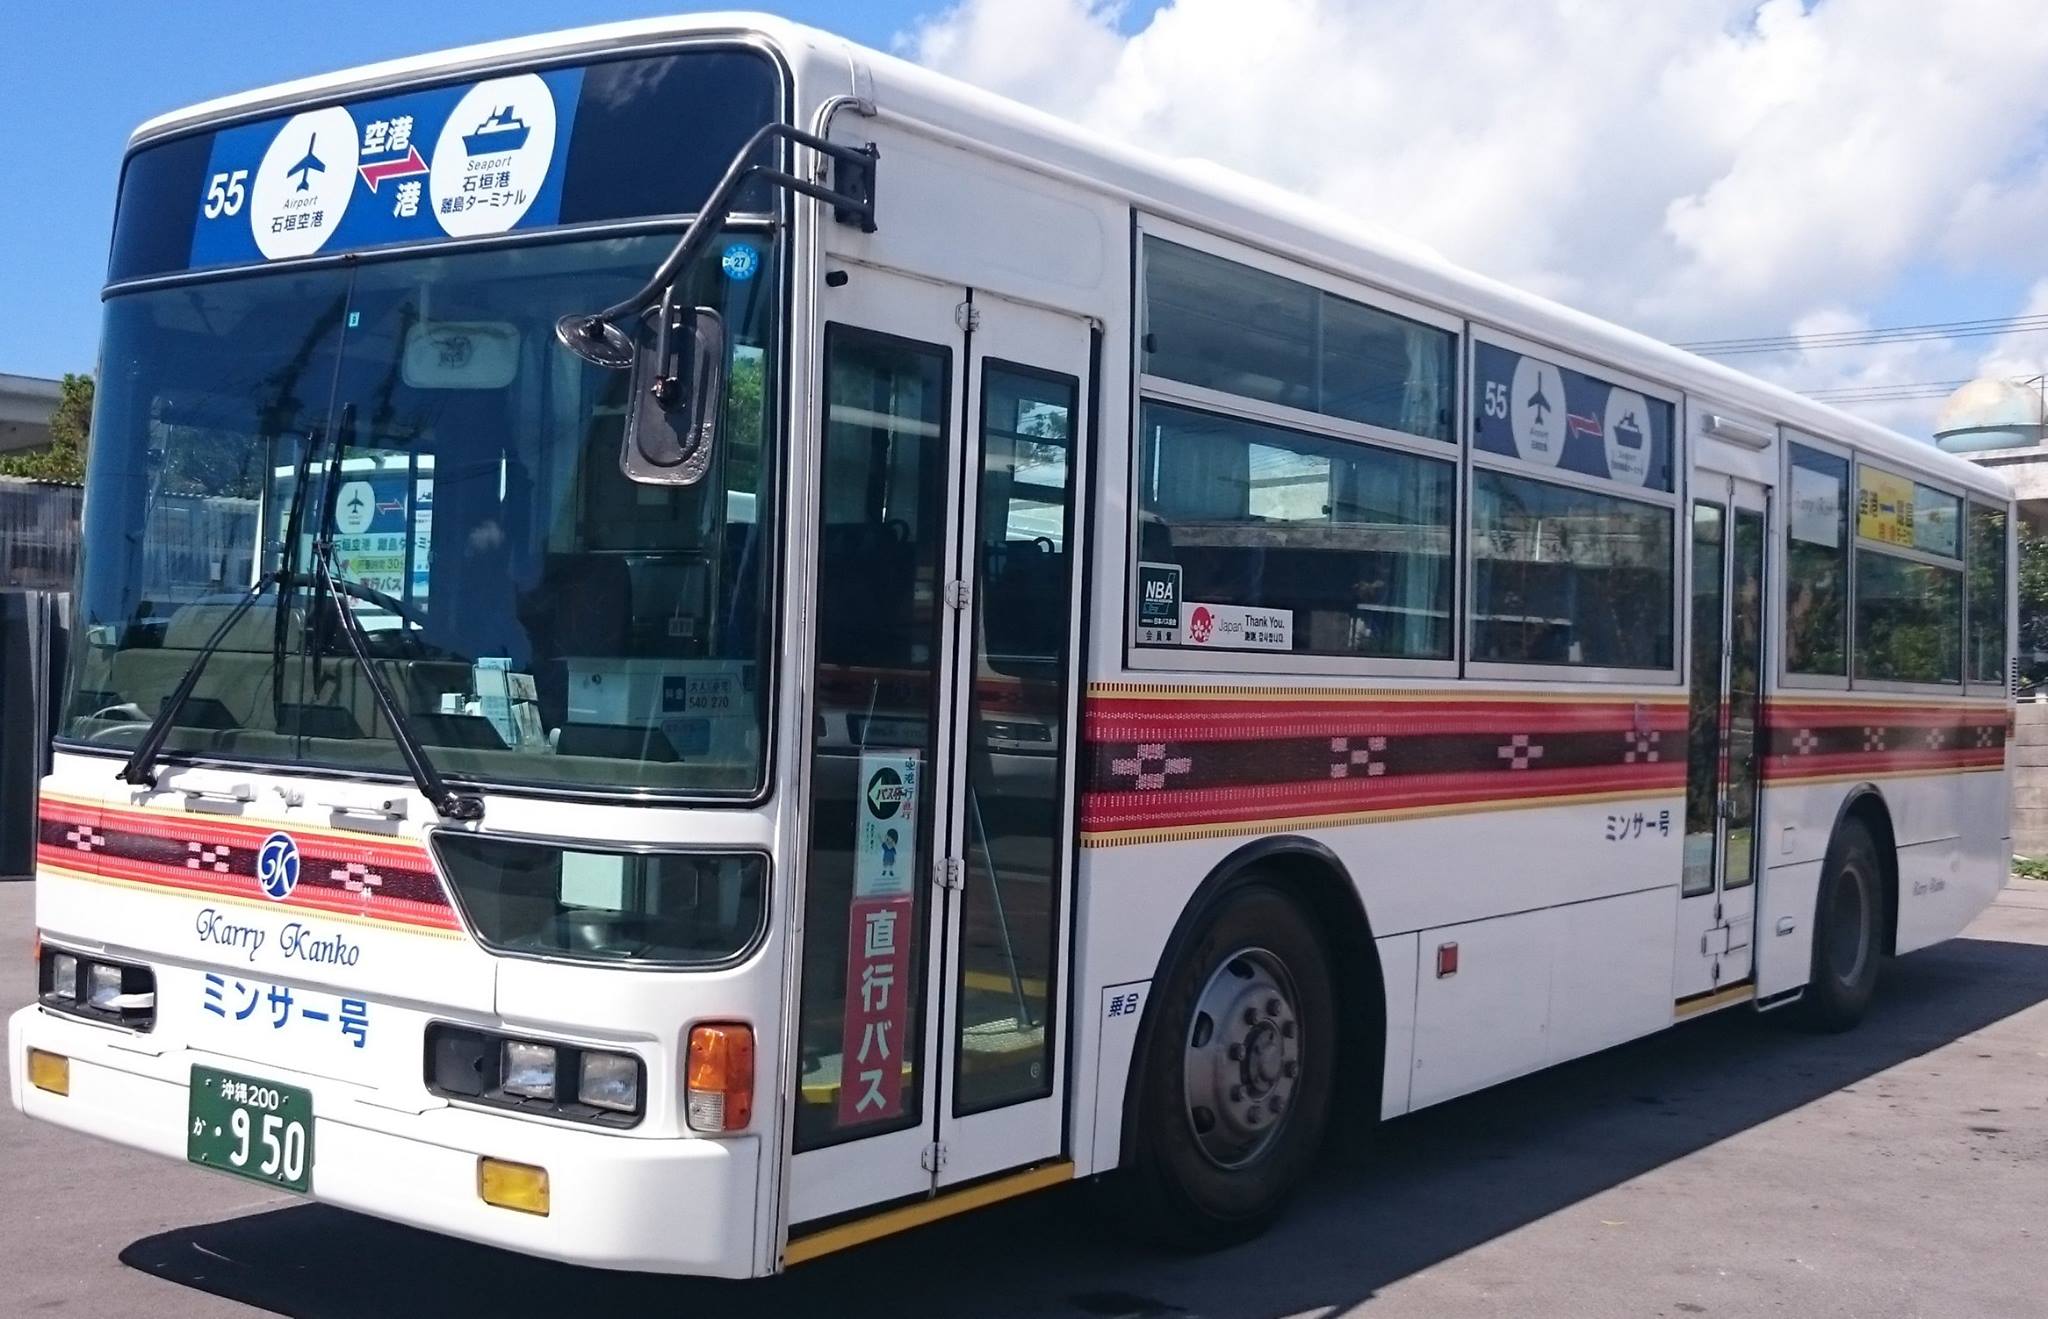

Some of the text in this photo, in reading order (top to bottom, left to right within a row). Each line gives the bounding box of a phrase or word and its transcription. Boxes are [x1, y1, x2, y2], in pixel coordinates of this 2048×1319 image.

[361, 115, 414, 155] 空港
[467, 155, 512, 173] Seaport
[204, 169, 248, 219] 55
[462, 171, 511, 193] 石垣港
[283, 195, 318, 210] Airport
[393, 181, 422, 218] 港
[440, 189, 527, 215] 離島ターミナル
[270, 210, 324, 234] 石垣空港
[734, 257, 746, 268] 27
[1485, 380, 1507, 419] 55
[1145, 581, 1173, 599] NBA
[1245, 614, 1267, 627] Thank
[1269, 616, 1284, 628] You.
[1606, 810, 1670, 841] ミンサー号
[196, 908, 360, 966] Karry Kanko
[203, 973, 369, 1049] ミンサー号
[855, 909, 898, 1114] 直行バス
[1108, 992, 1139, 1018] 乗合
